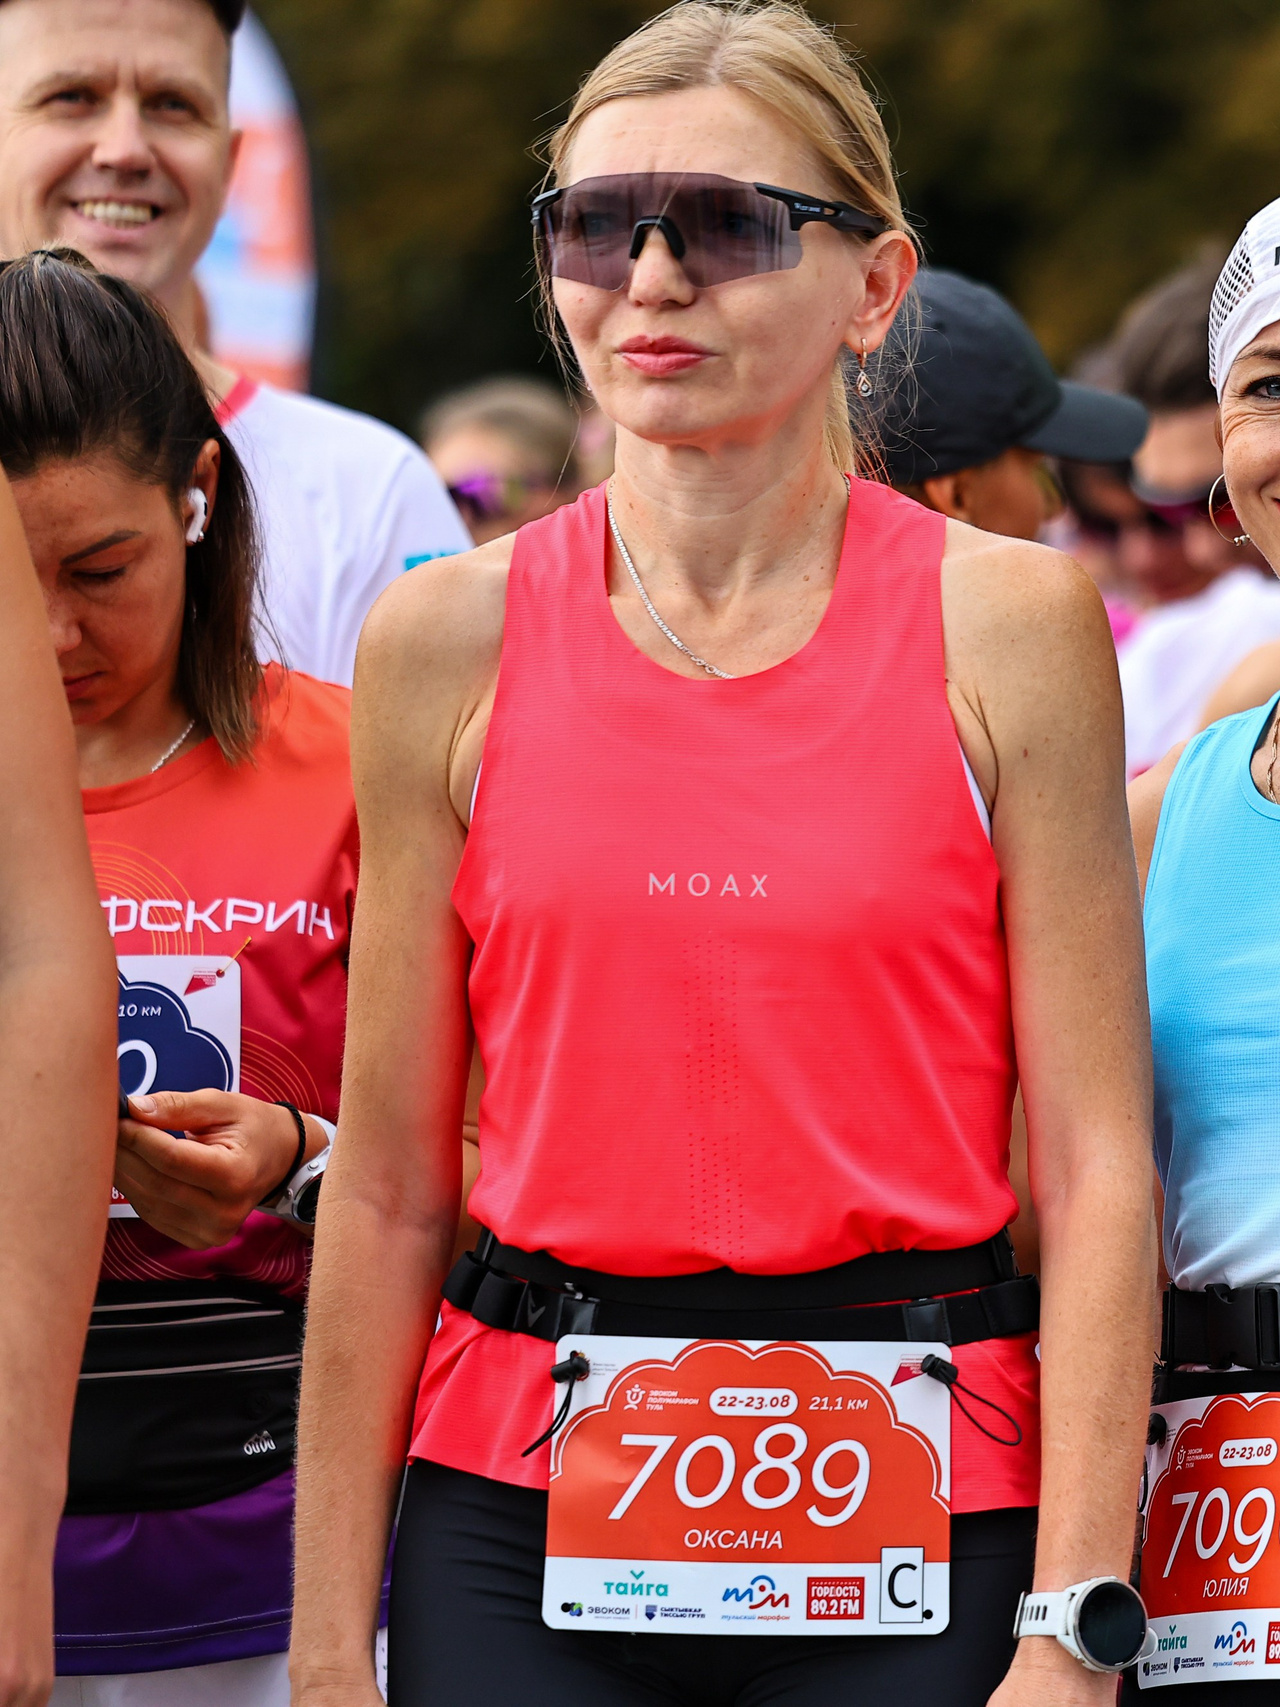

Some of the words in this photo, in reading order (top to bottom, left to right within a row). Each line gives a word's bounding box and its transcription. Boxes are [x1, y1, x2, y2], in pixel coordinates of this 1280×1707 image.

[648, 872, 768, 898] MOAX
[101, 895, 335, 940] ФСКРИН
[716, 1393, 791, 1411] 22-23.08
[808, 1395, 843, 1412] 21,1
[1222, 1443, 1273, 1461] 22-23.08
[607, 1422, 871, 1528] 7089
[683, 1528, 784, 1550] ОКСАНА
[604, 1569, 669, 1597] тайга
[811, 1586, 861, 1598] ГОРДОСТЬ
[1202, 1576, 1250, 1599] ЮЛИЯ
[587, 1606, 631, 1616] ЭВОКОМ
[810, 1599, 838, 1615] 89.2
[840, 1599, 860, 1615] FM
